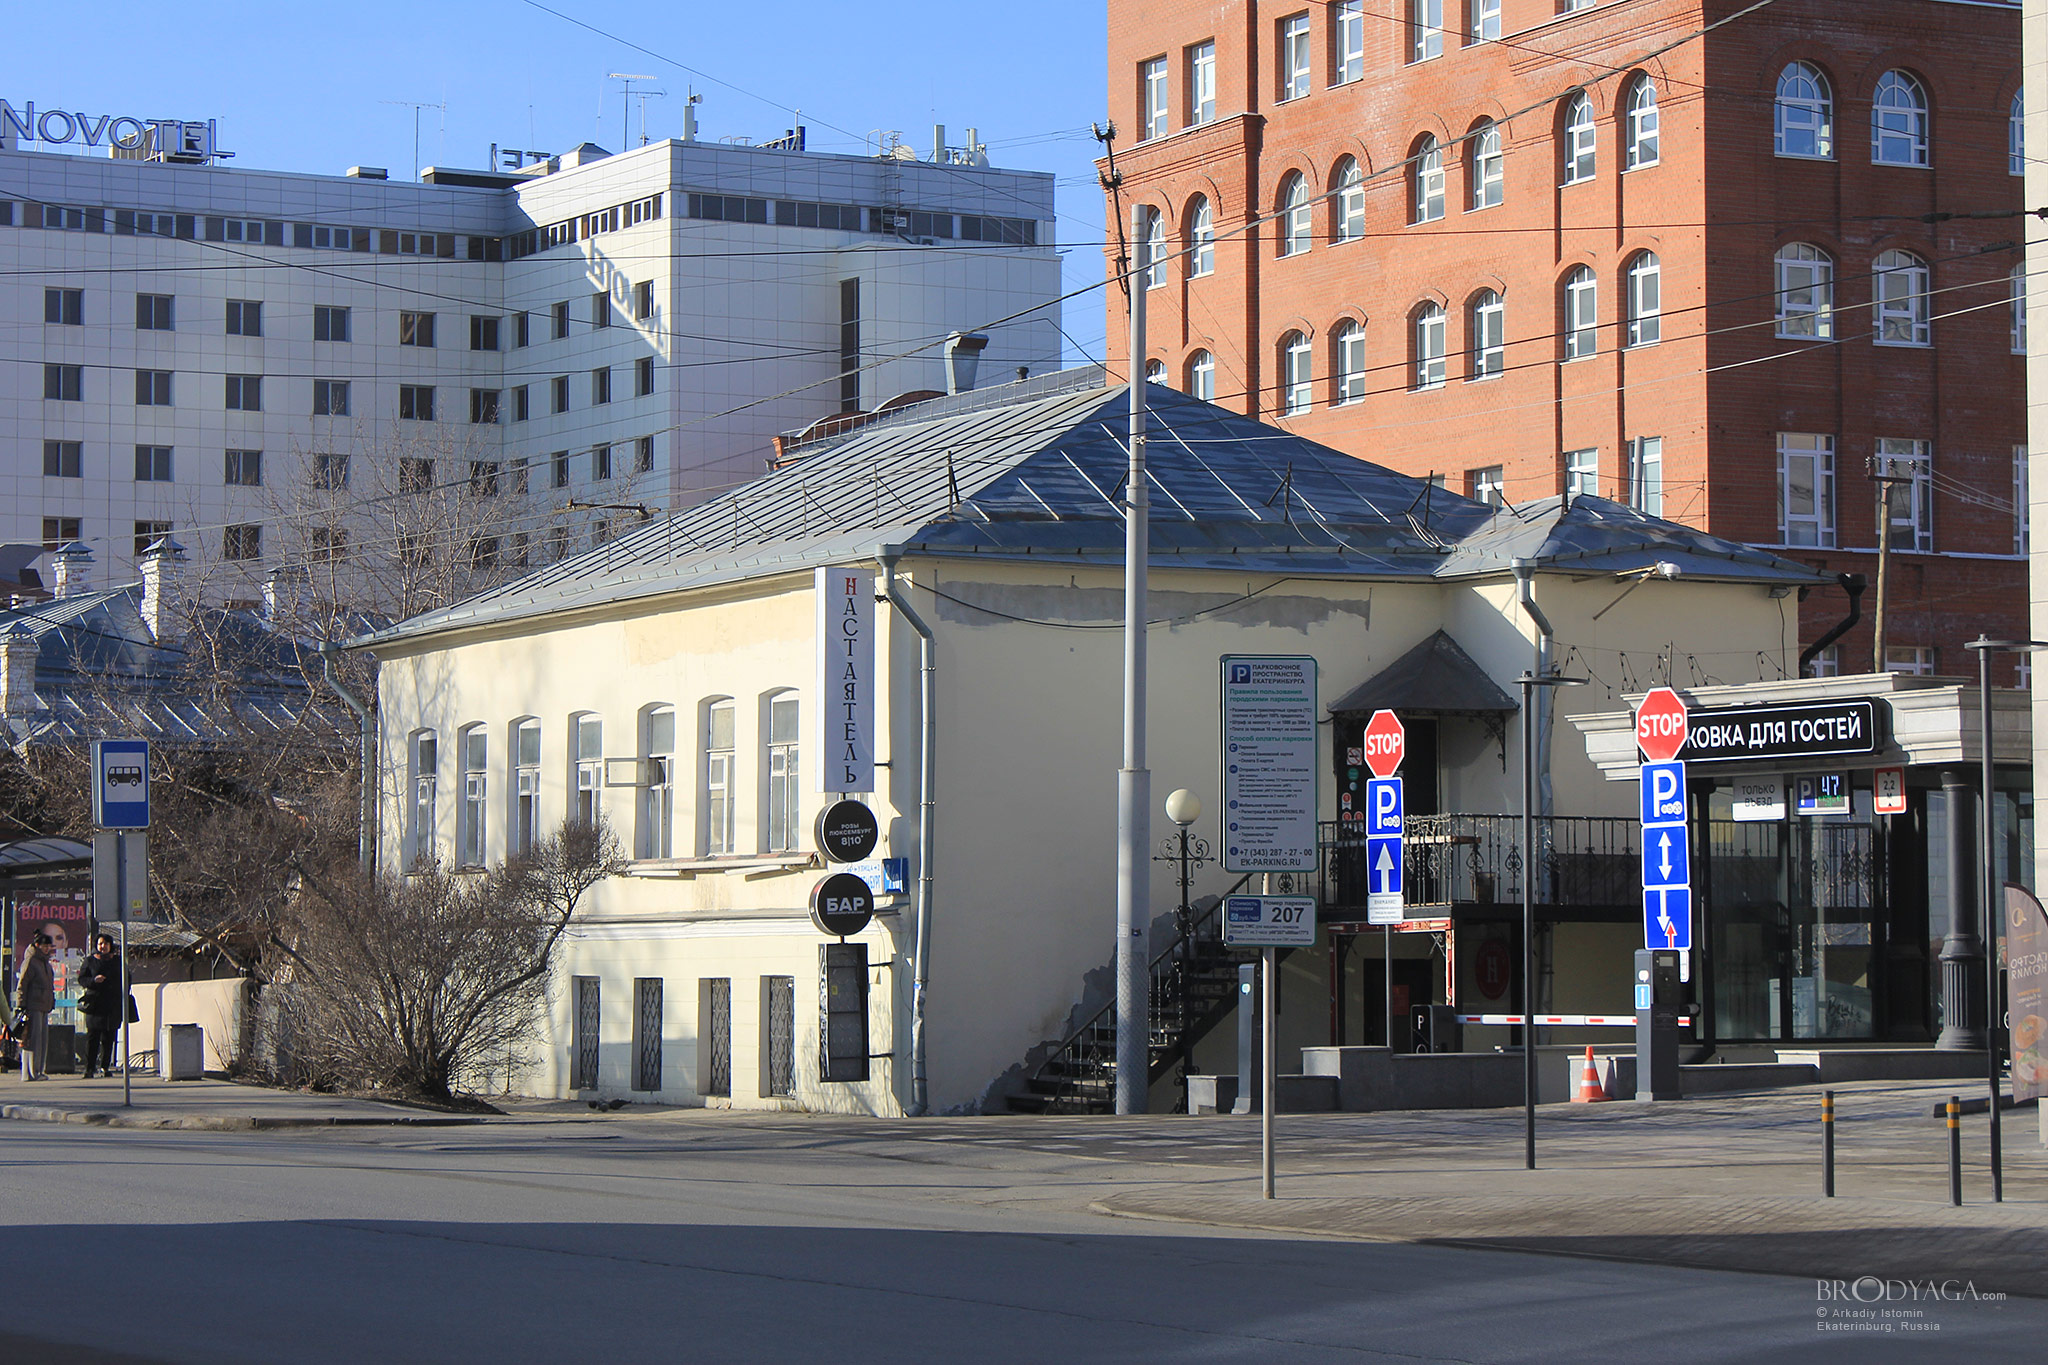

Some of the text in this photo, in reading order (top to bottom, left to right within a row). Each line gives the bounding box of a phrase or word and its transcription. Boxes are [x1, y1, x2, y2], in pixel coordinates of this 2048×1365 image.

[0, 99, 235, 159] NOVOTEL
[1639, 713, 1683, 738] STOP
[1687, 711, 1862, 750] КОВКА ДЛЯ ГОСТЕЙ
[1367, 733, 1401, 756] STOP
[1741, 784, 1776, 796] ТОЛЬКО
[1821, 775, 1840, 796] 47
[1883, 780, 1895, 791] 2,2
[1744, 796, 1773, 808] ВЪЕЗД
[829, 828, 872, 836] ЛЮКСЕМБУРГ
[1250, 849, 1268, 858] (343)
[1240, 858, 1301, 866] EK-PARKING.RU
[826, 897, 865, 912] БАР
[21, 905, 86, 920] ВЛАСОВА
[1271, 907, 1305, 923] 207
